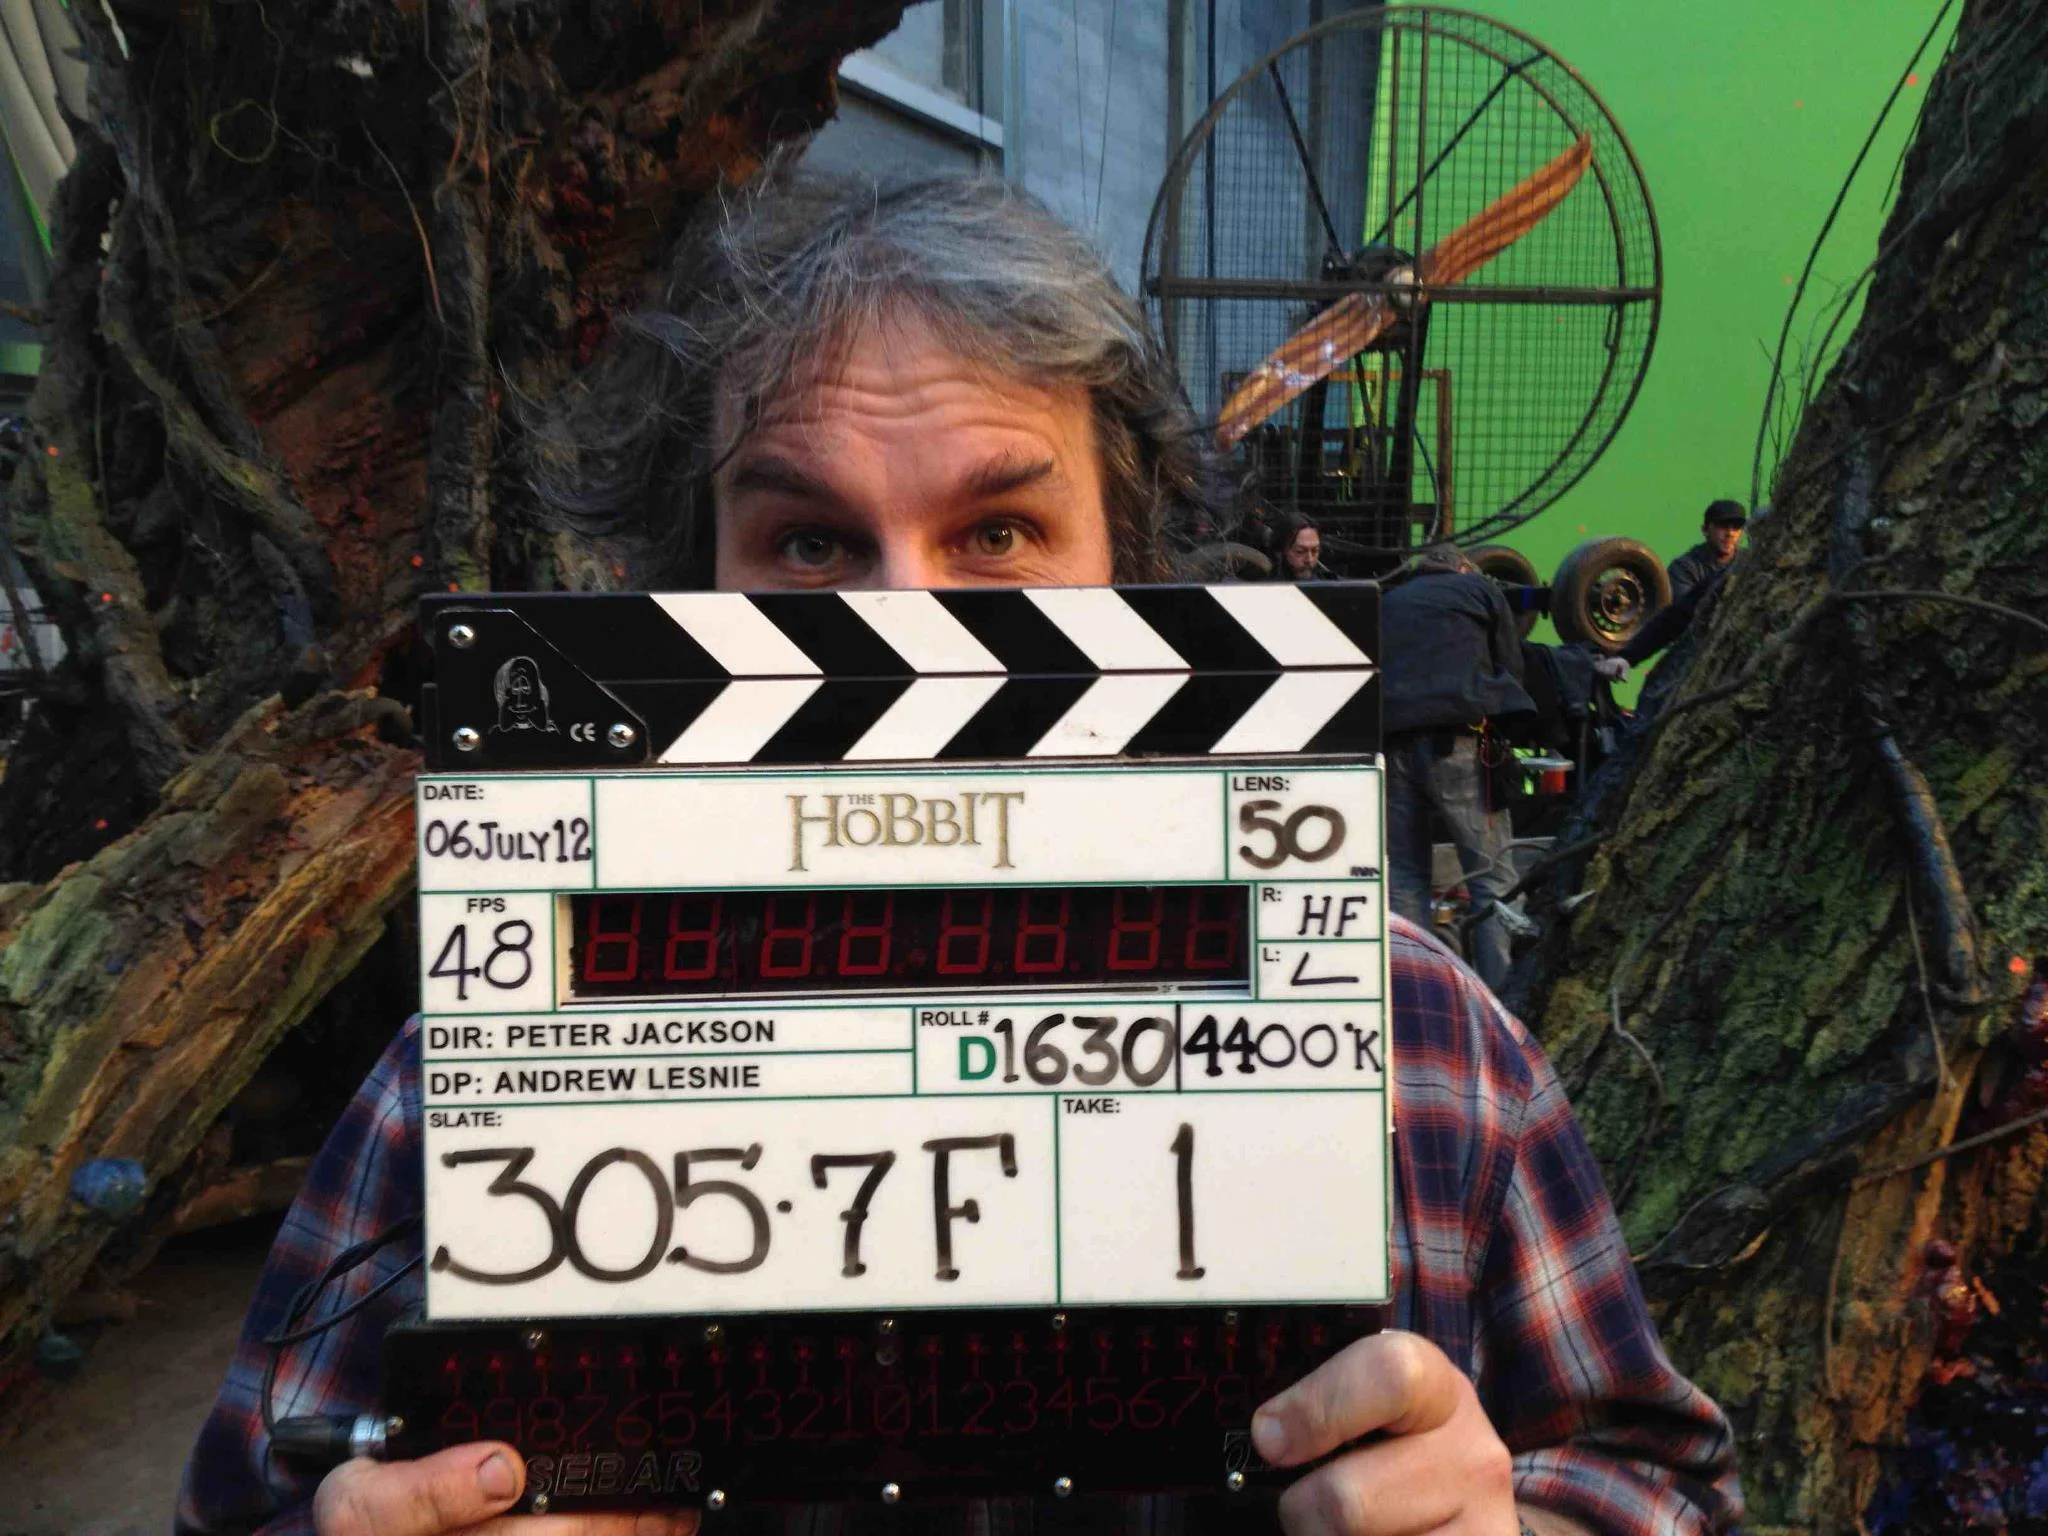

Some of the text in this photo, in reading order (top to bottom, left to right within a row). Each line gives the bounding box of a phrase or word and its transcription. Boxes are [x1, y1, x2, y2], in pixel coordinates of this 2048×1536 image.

[1233, 776, 1290, 792] LENS:
[424, 785, 484, 800] DATE:
[848, 794, 875, 805] THE
[1239, 799, 1346, 869] 50
[1263, 888, 1282, 902] R:
[467, 898, 506, 913] FPS
[1298, 895, 1367, 936] HF
[428, 920, 534, 1000] 48
[1263, 948, 1281, 962] L:
[429, 1020, 775, 1050] DIR: PETER JACKSON
[430, 1065, 761, 1095] DP: ANDREW LESNIE
[1063, 1099, 1122, 1115] TAKE:
[429, 1112, 502, 1128] SLATE:
[1169, 1122, 1206, 1281] 1
